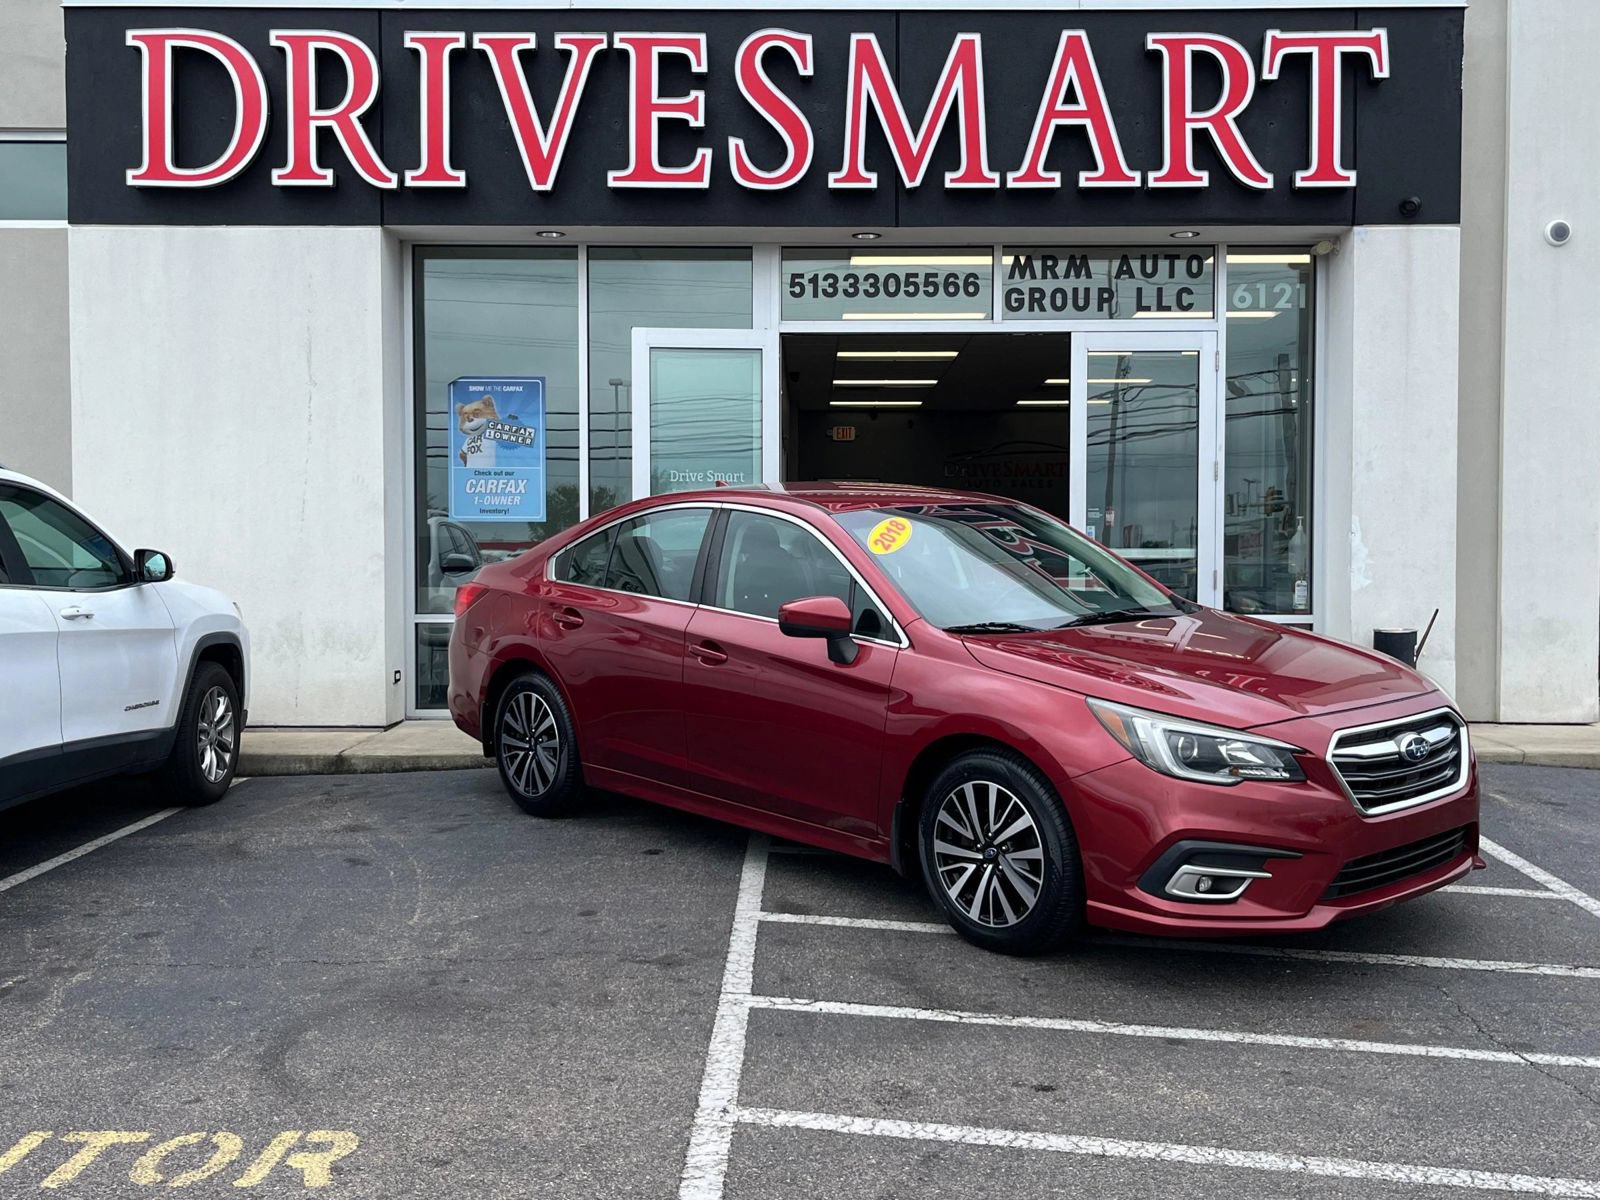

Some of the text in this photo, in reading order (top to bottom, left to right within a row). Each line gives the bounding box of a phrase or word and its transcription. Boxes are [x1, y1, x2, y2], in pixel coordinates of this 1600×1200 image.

[125, 27, 1391, 192] DRIVESMART
[1008, 254, 1204, 280] MRM AUTO
[789, 272, 980, 298] 5133305566
[1232, 282, 1307, 309] 6121
[1004, 287, 1194, 312] GROUP LLC
[487, 421, 535, 438] CARFAX
[466, 478, 528, 494] CARFAX
[670, 469, 745, 483] Drive Smart
[474, 496, 521, 505] 1-OWNER
[874, 520, 906, 551] 2018
